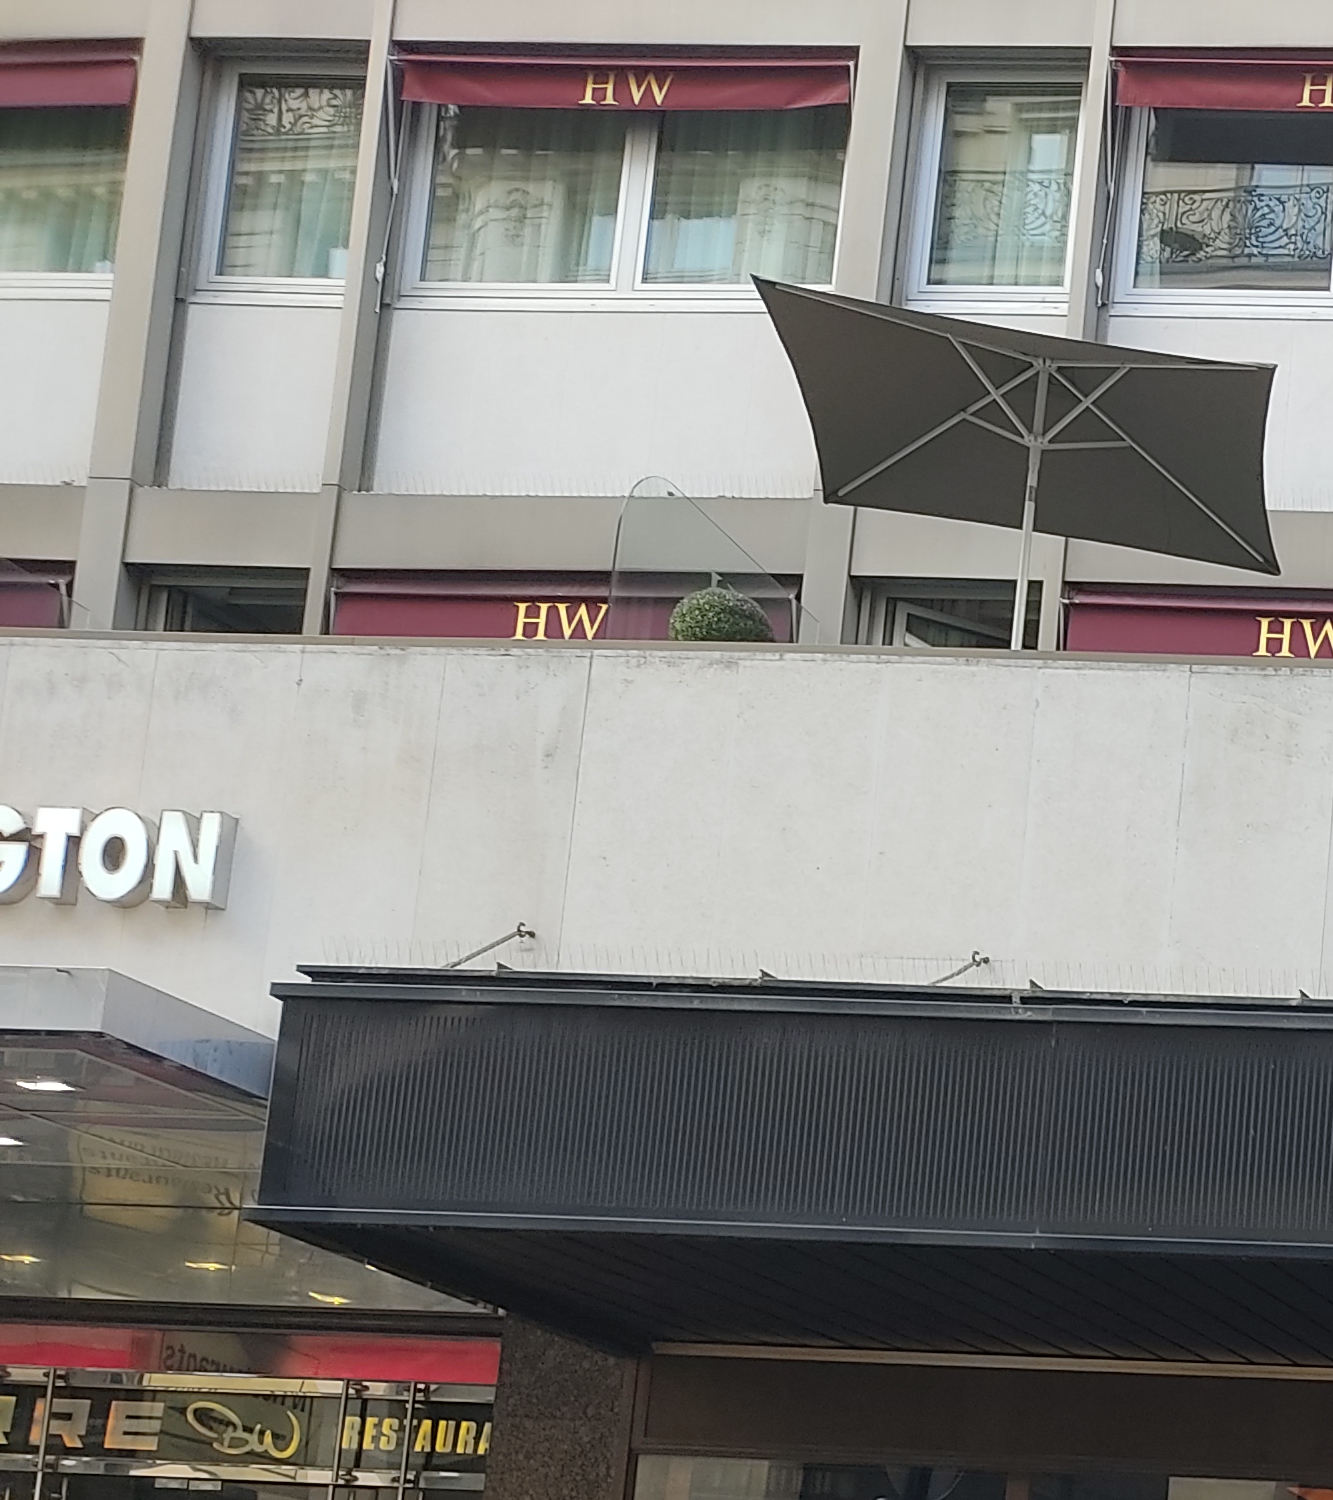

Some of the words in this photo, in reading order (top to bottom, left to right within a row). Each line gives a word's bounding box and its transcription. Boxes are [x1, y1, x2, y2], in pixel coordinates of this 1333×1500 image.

[577, 70, 674, 107] HW
[512, 601, 608, 642] HW
[0, 1395, 165, 1451] RE
